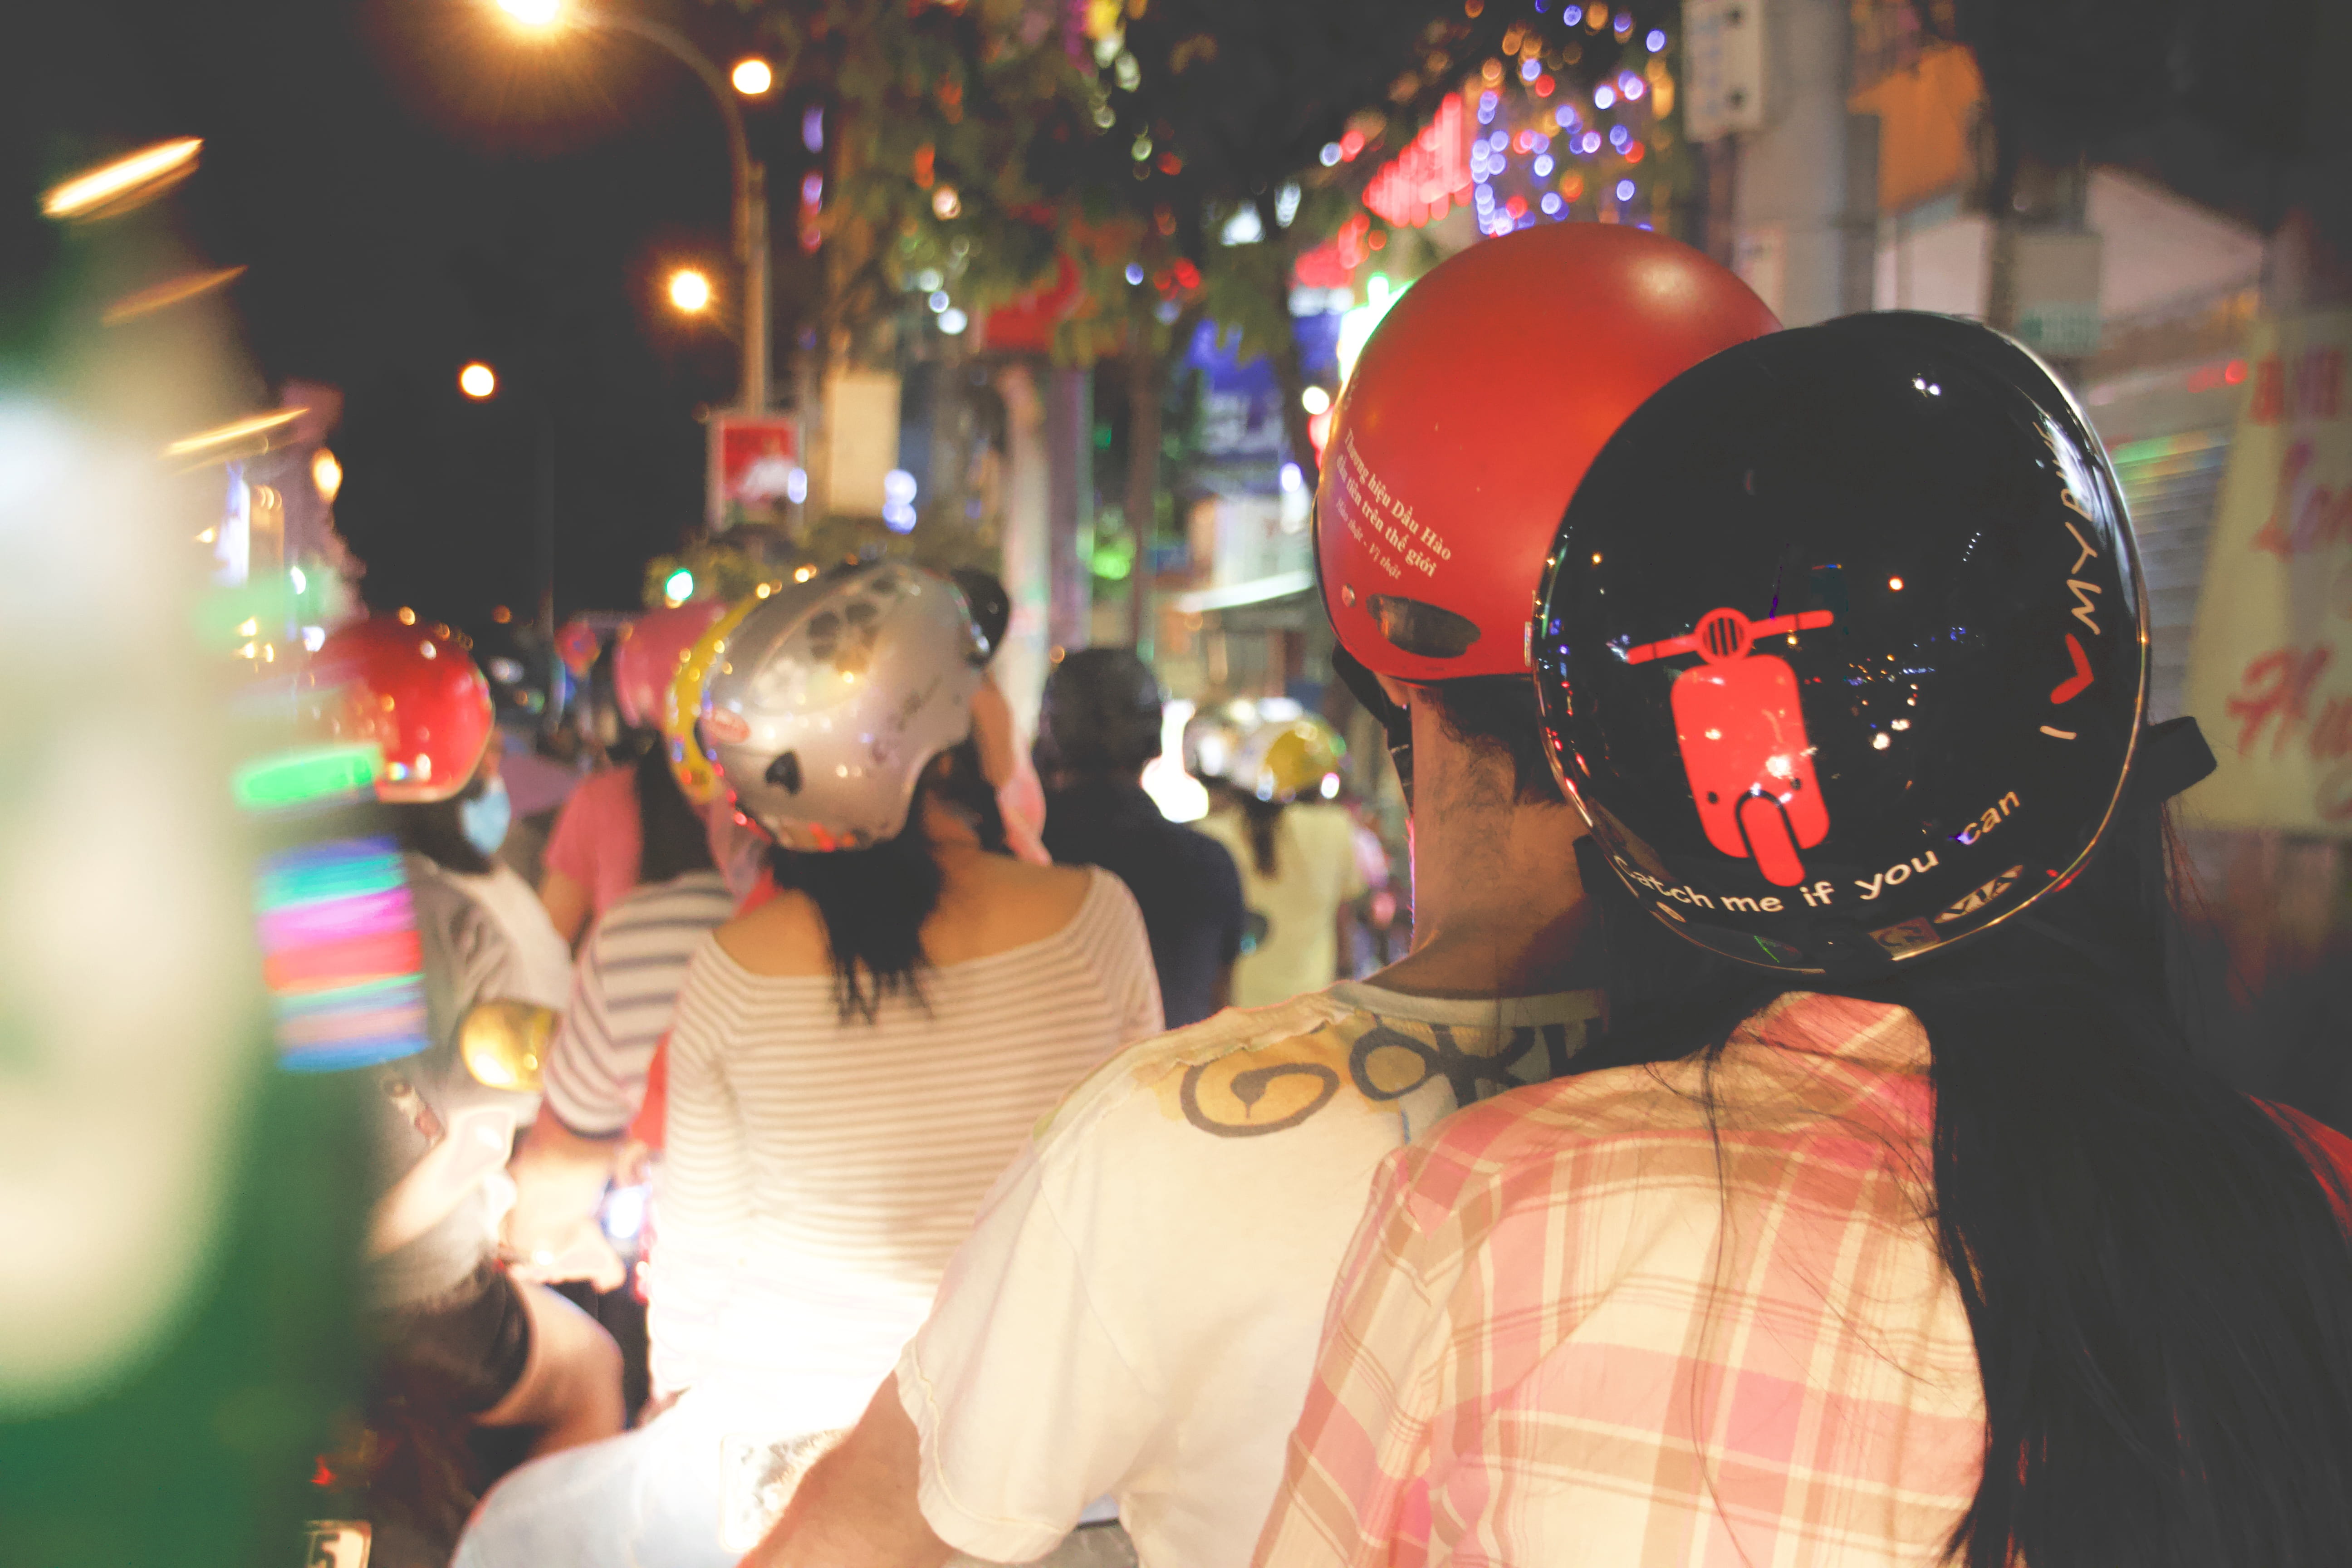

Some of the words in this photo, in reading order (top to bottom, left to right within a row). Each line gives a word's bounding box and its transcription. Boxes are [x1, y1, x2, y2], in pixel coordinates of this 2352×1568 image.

[1347, 477, 1362, 507] tiên
[1362, 500, 1384, 533] trên
[1385, 526, 1410, 553] thế
[1405, 548, 1437, 578] giới
[1368, 473, 1391, 508] hiệu
[1391, 499, 1420, 535] Dầu
[1420, 526, 1451, 561] Hào
[1613, 855, 1715, 909] Catch
[1720, 896, 1784, 912] me
[1799, 881, 1835, 907] if
[1854, 850, 1939, 901] you
[1962, 791, 2020, 845] can
